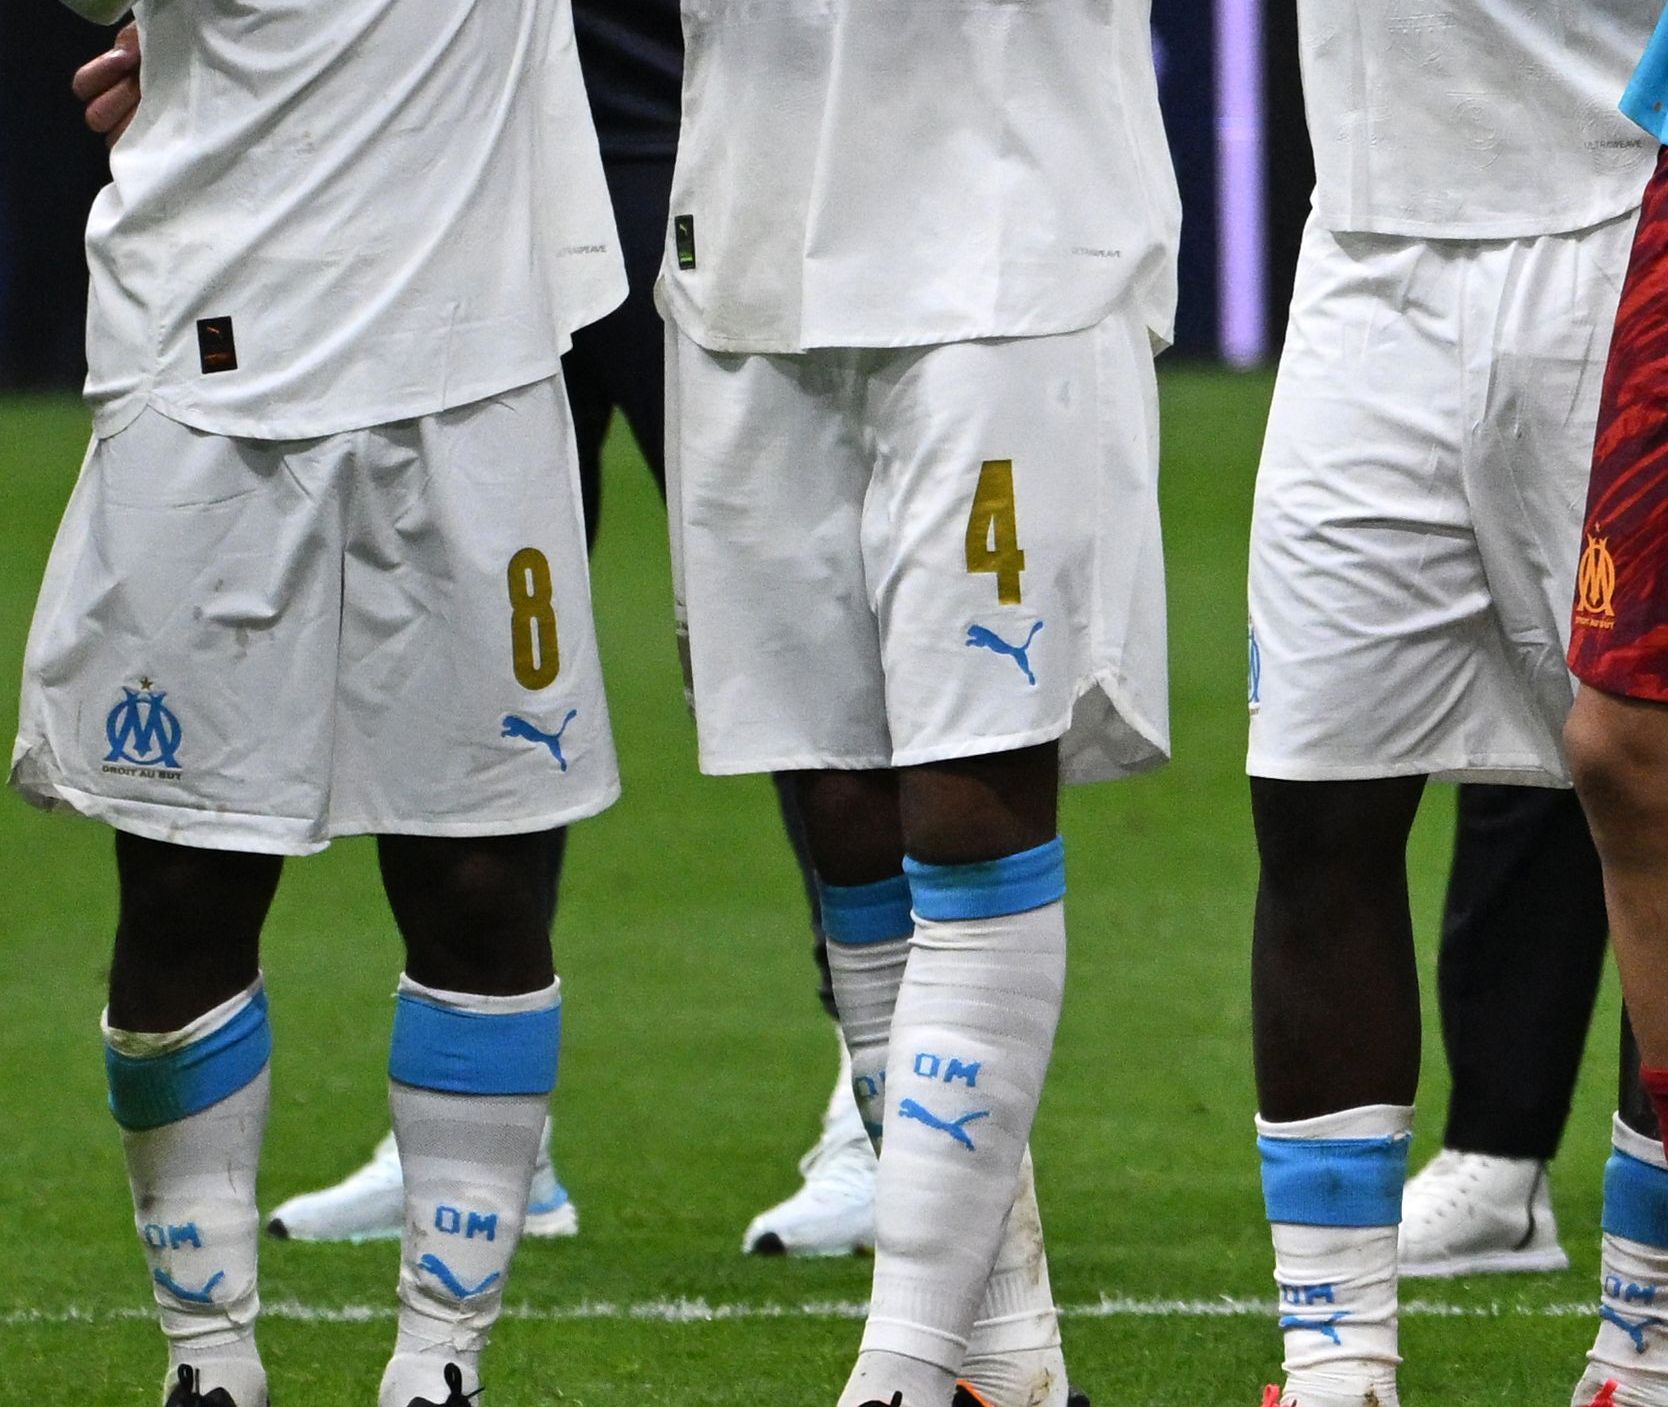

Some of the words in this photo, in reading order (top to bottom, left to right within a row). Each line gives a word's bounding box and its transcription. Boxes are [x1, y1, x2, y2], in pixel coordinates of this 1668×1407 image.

[965, 459, 1025, 605] 4
[507, 547, 560, 691] 8
[102, 765, 136, 776] DROIT
[140, 769, 155, 778] AU
[158, 770, 181, 780] BUT
[853, 1071, 886, 1099] O
[914, 1052, 982, 1087] OM
[144, 1222, 202, 1250] OM
[435, 1205, 498, 1242] OM
